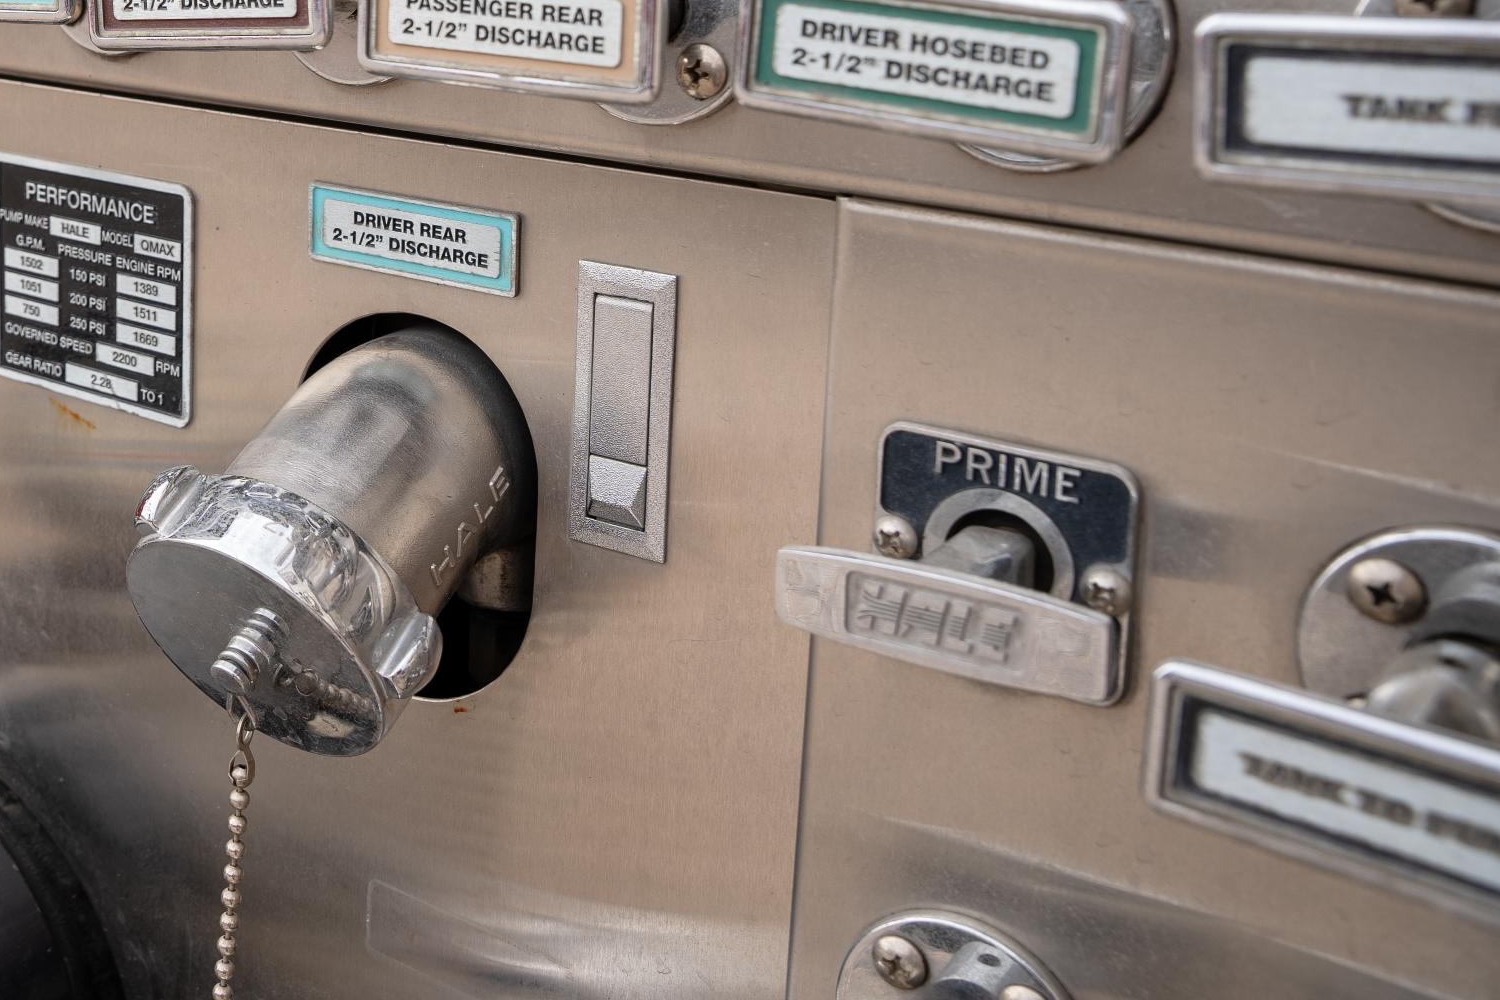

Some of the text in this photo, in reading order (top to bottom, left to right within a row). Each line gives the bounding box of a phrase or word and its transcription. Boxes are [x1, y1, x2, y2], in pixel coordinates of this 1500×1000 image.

[402, 18, 605, 55] 2-1/2" DISCHARGE
[541, 4, 603, 27] REAR
[800, 18, 1050, 70] DRIVER HOSEBED
[792, 47, 1056, 102] 2-1/2" DISCHARGE
[25, 181, 155, 224] PERFORMANCE
[0, 208, 174, 257] PUMP MAKE HALE MODEL QMAX
[332, 228, 489, 269] 2-1/2" DISCHARGE
[353, 210, 467, 244] DRIVER REAR
[16, 234, 181, 281] G.P.M. PRESSURE ENGINE RPM
[20, 255, 159, 297] 1502 150 PSI 1389
[20, 279, 158, 322] 1051 200 PSI 1511
[23, 303, 40, 317] 750
[70, 316, 87, 331] 250
[89, 321, 106, 335] PSI
[5, 322, 181, 377] GOVERNED SPEED 2200 RPM
[5, 352, 164, 405] GEAR RATIO 2.28 TO 1
[933, 440, 1083, 504] PRIME
[430, 465, 510, 586] HALE
